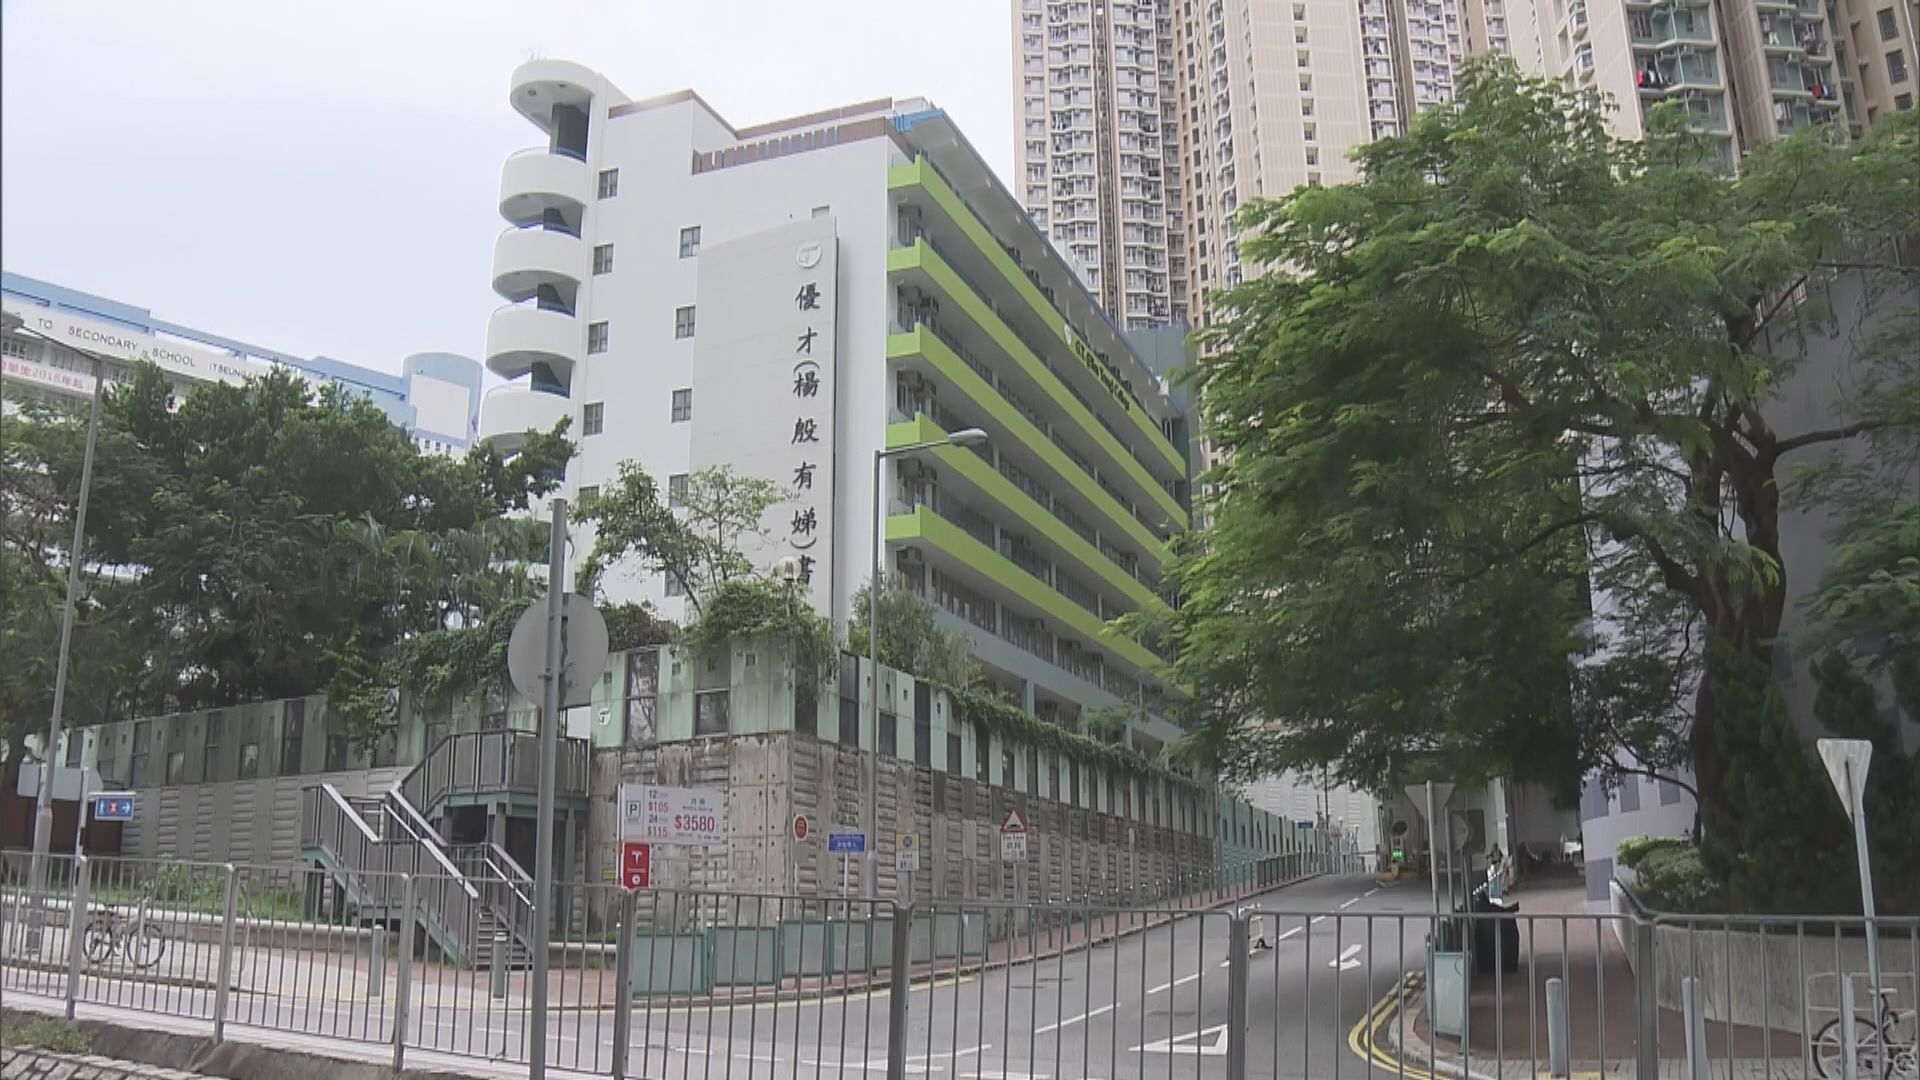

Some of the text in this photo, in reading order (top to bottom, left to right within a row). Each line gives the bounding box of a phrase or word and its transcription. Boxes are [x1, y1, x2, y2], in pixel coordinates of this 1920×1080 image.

[38, 318, 53, 330] TO
[69, 326, 138, 351] SECONDARY
[152, 347, 196, 367] SCHOOL
[649, 790, 657, 799] 12
[649, 815, 658, 823] 24
[675, 814, 714, 832] $3580
[647, 825, 668, 838] $115
